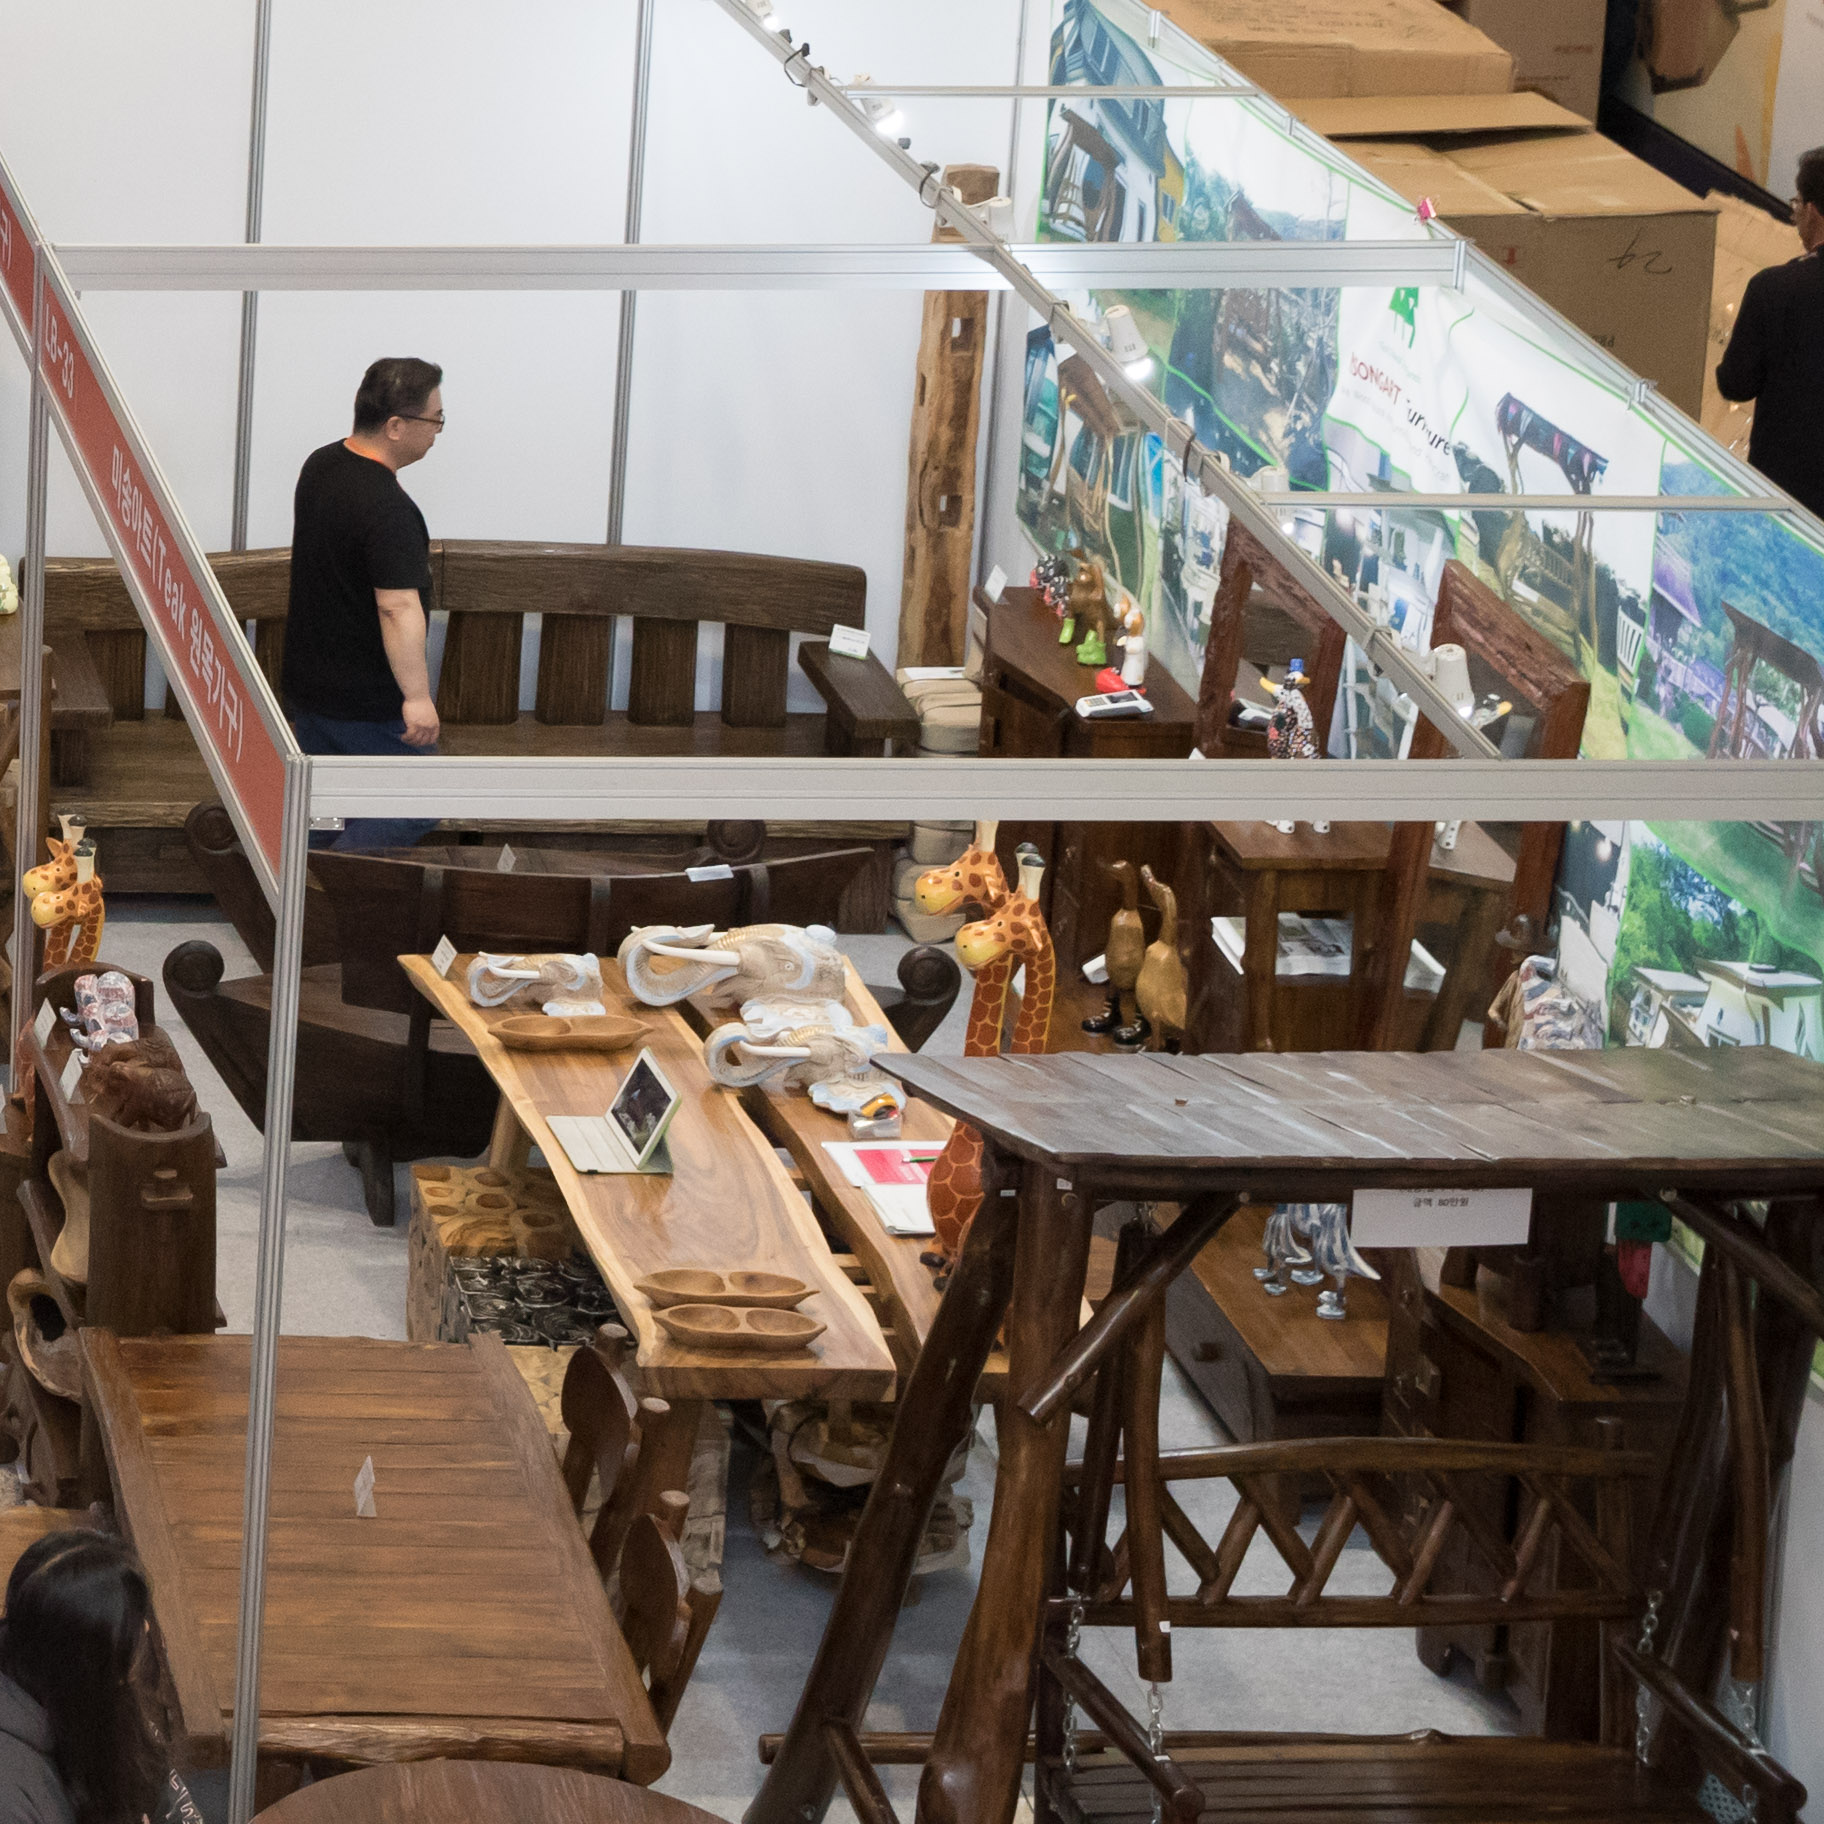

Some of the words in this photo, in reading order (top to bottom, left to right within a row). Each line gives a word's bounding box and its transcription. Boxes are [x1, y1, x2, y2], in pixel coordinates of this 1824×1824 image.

[43, 302, 77, 400] LB-33
[111, 443, 187, 637] 미송아트(Teak
[188, 598, 246, 764] 원목가구)
